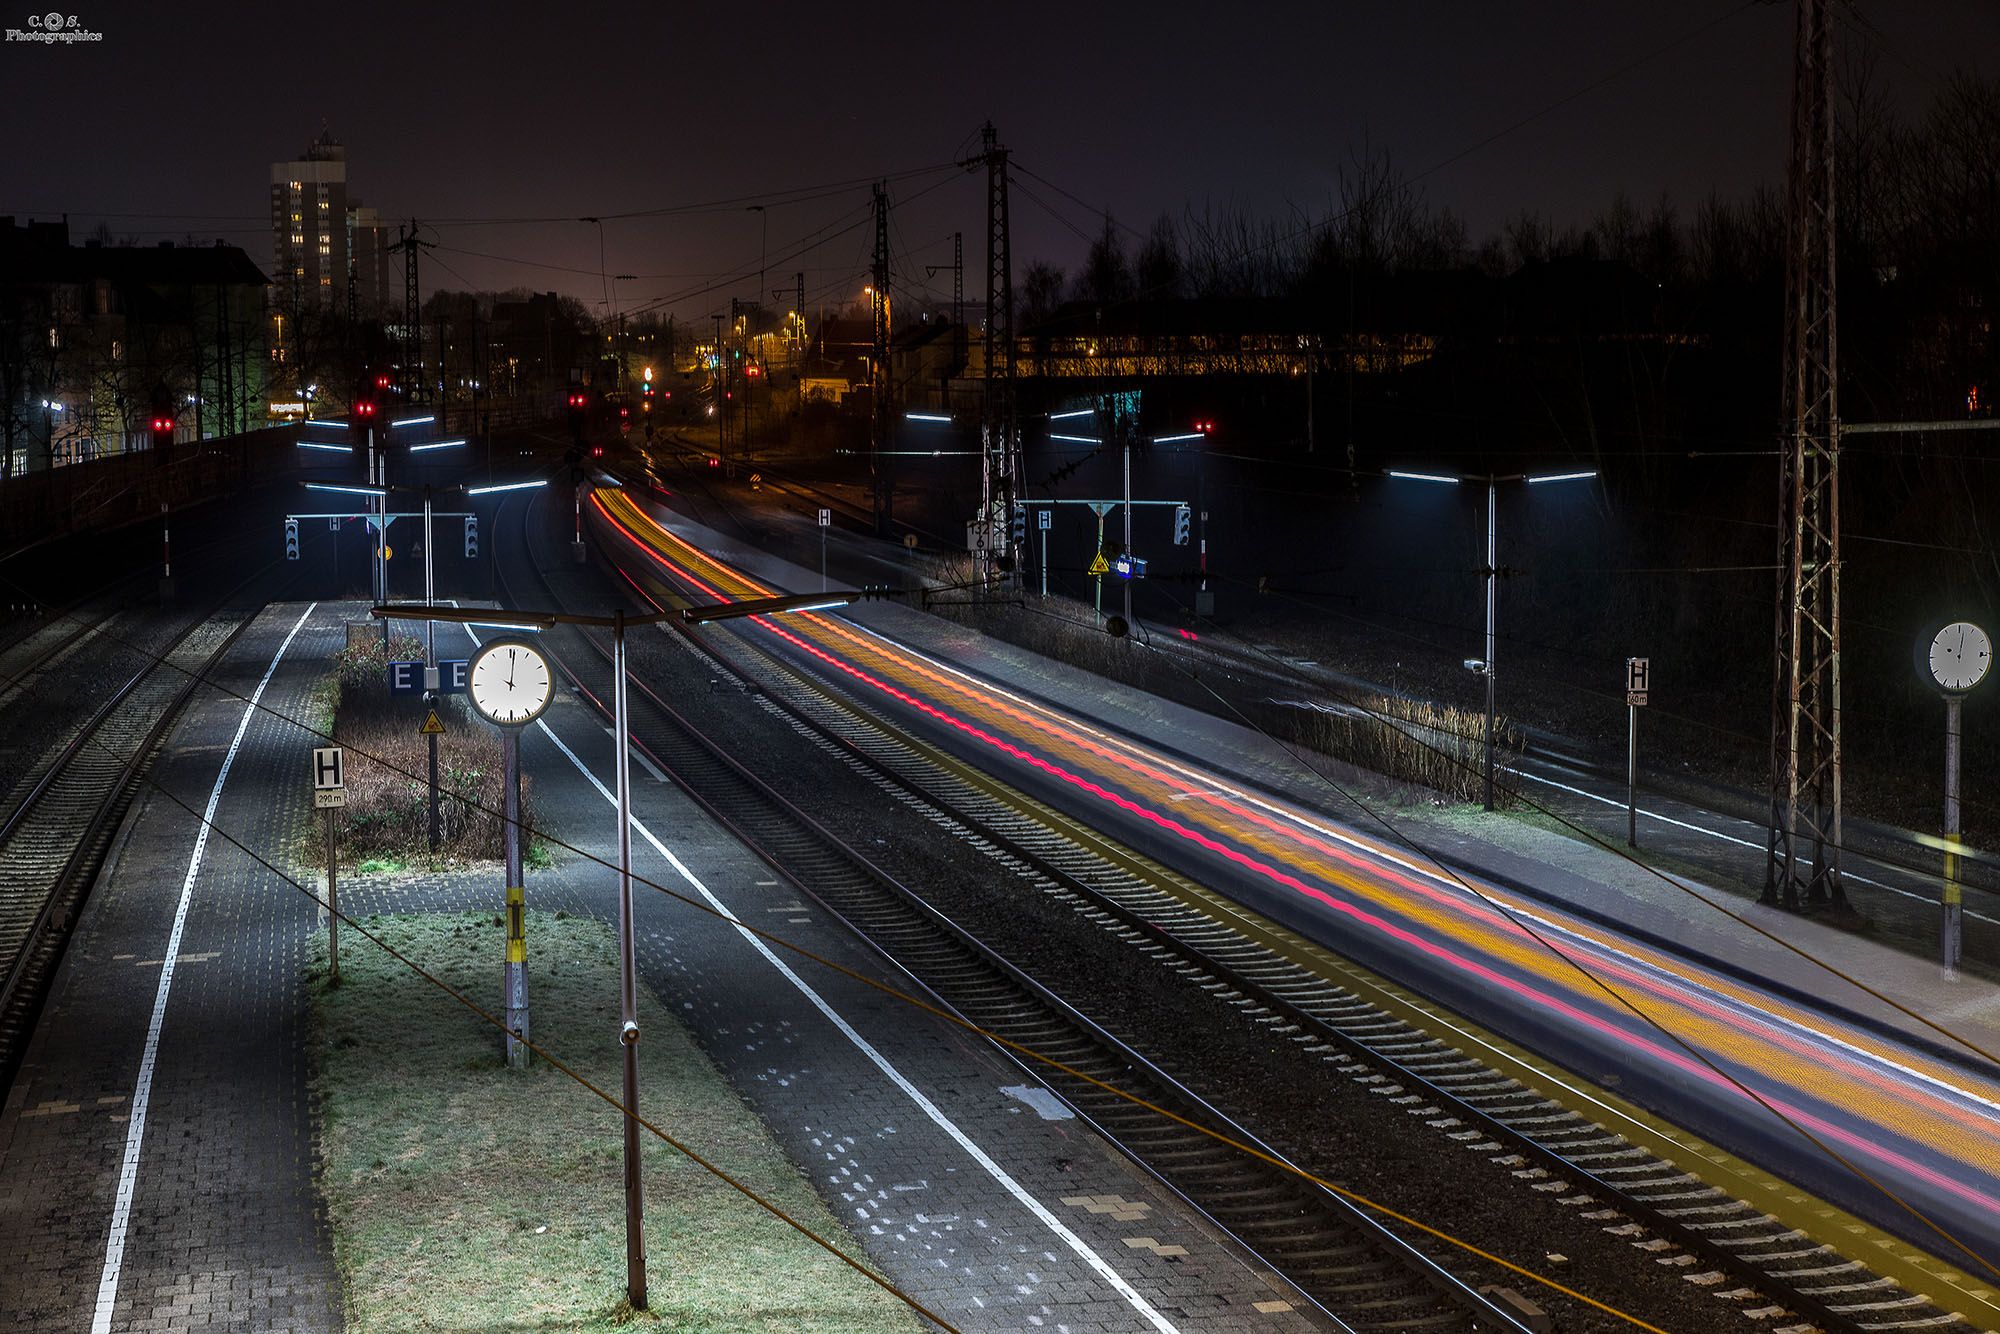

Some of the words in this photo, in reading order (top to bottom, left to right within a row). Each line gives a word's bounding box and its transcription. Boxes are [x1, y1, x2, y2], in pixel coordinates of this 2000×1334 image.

[820, 510, 829, 525] H
[1040, 512, 1050, 527] H
[969, 522, 989, 535] 132
[976, 536, 985, 549] 6
[395, 664, 411, 688] E
[452, 662, 468, 687] E
[1631, 661, 1646, 689] H
[317, 750, 341, 785] H
[318, 794, 333, 803] 290
[334, 795, 342, 803] m
